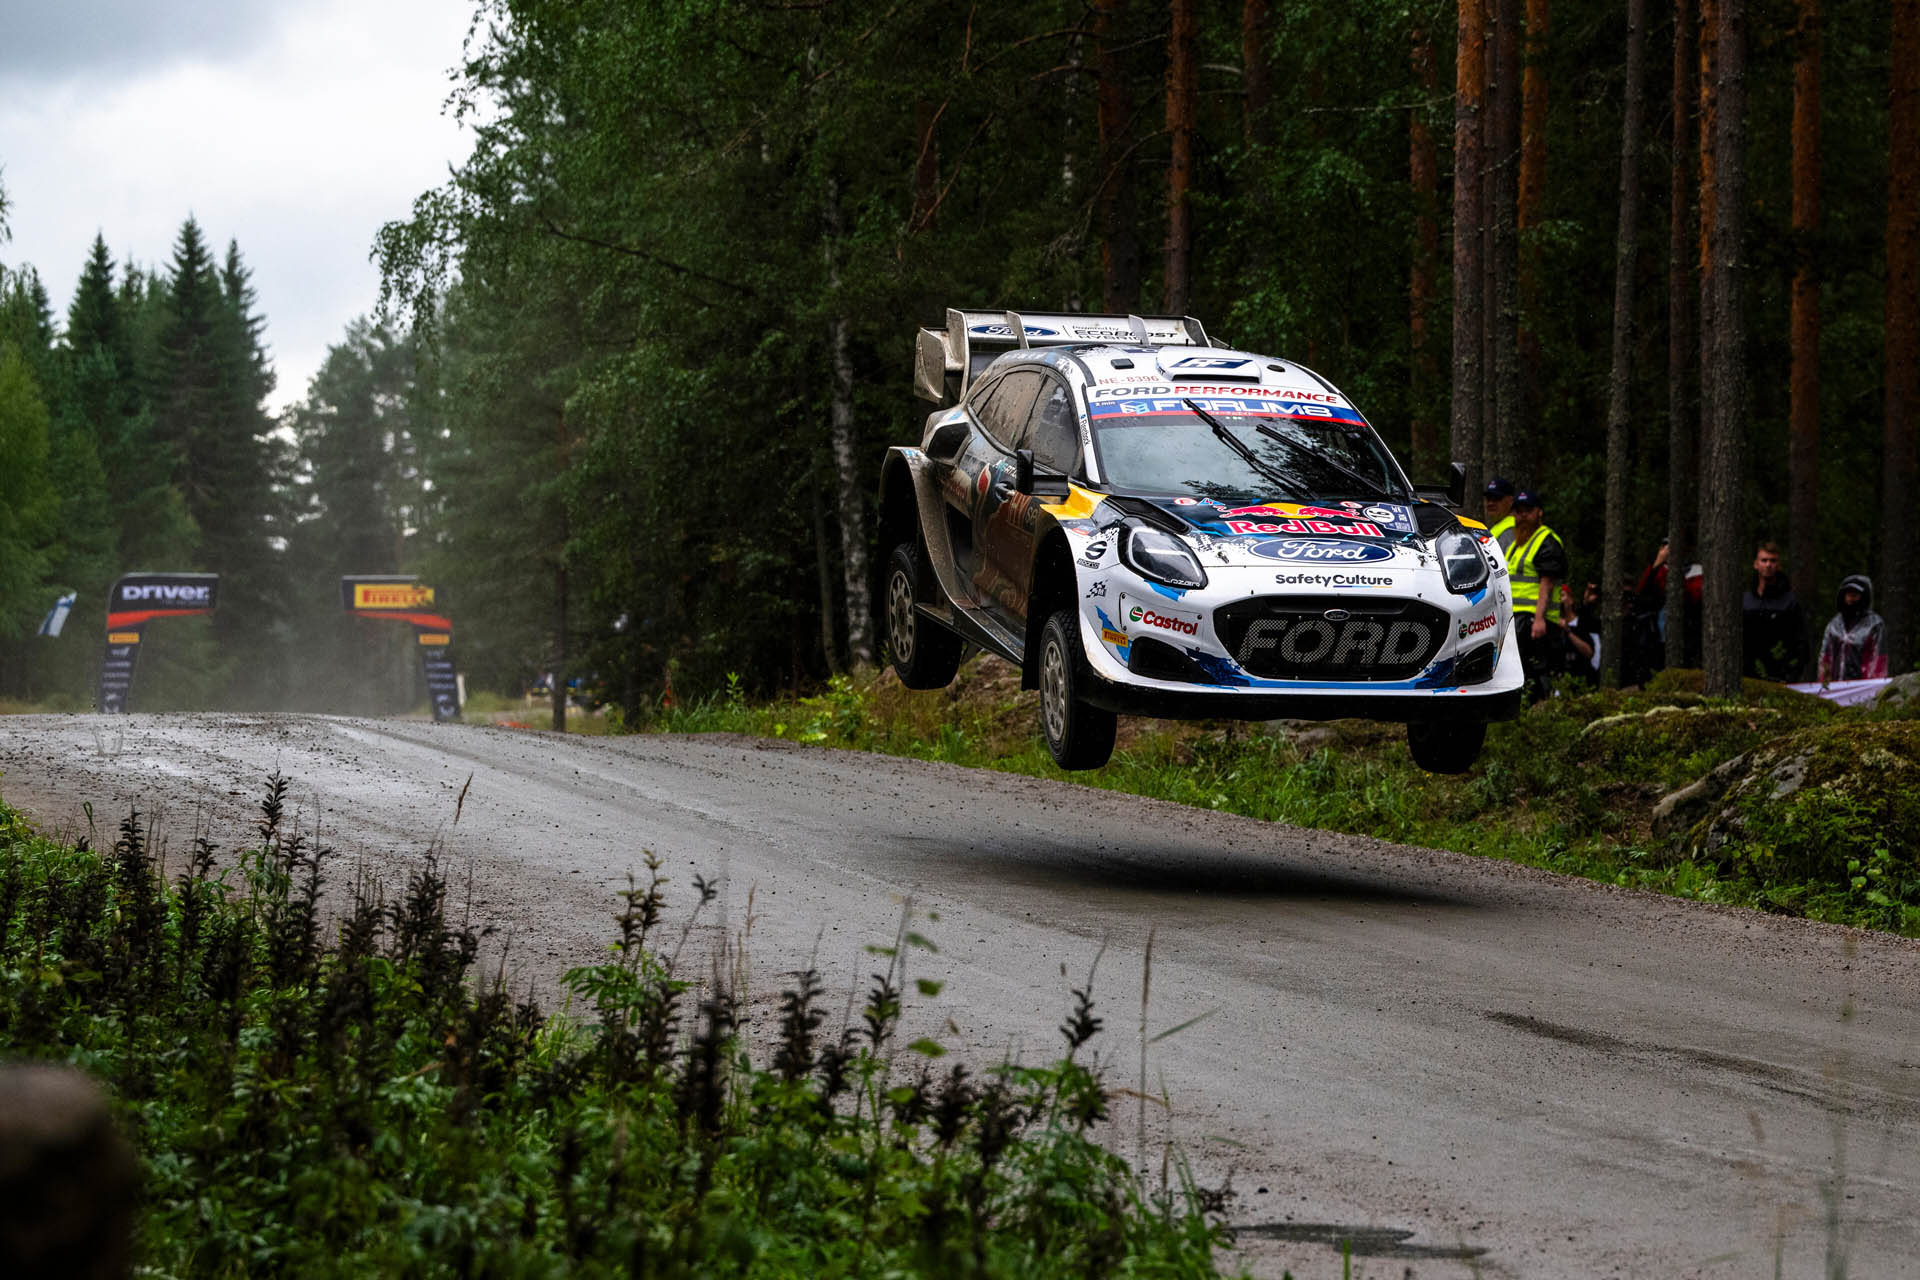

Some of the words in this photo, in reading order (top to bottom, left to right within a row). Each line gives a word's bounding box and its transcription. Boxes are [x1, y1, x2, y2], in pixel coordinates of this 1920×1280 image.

[1095, 386, 1171, 398] FORD
[1174, 386, 1338, 404] PERFORMANCE
[1152, 399, 1333, 417] FORUM8
[1225, 520, 1306, 534] Red
[1308, 520, 1385, 537] Bull
[1277, 540, 1369, 560] Ford
[1275, 573, 1393, 587] SafetyCulture
[1142, 610, 1199, 636] Castrol
[1467, 611, 1496, 636] Castrol
[1237, 618, 1433, 665] FORD
